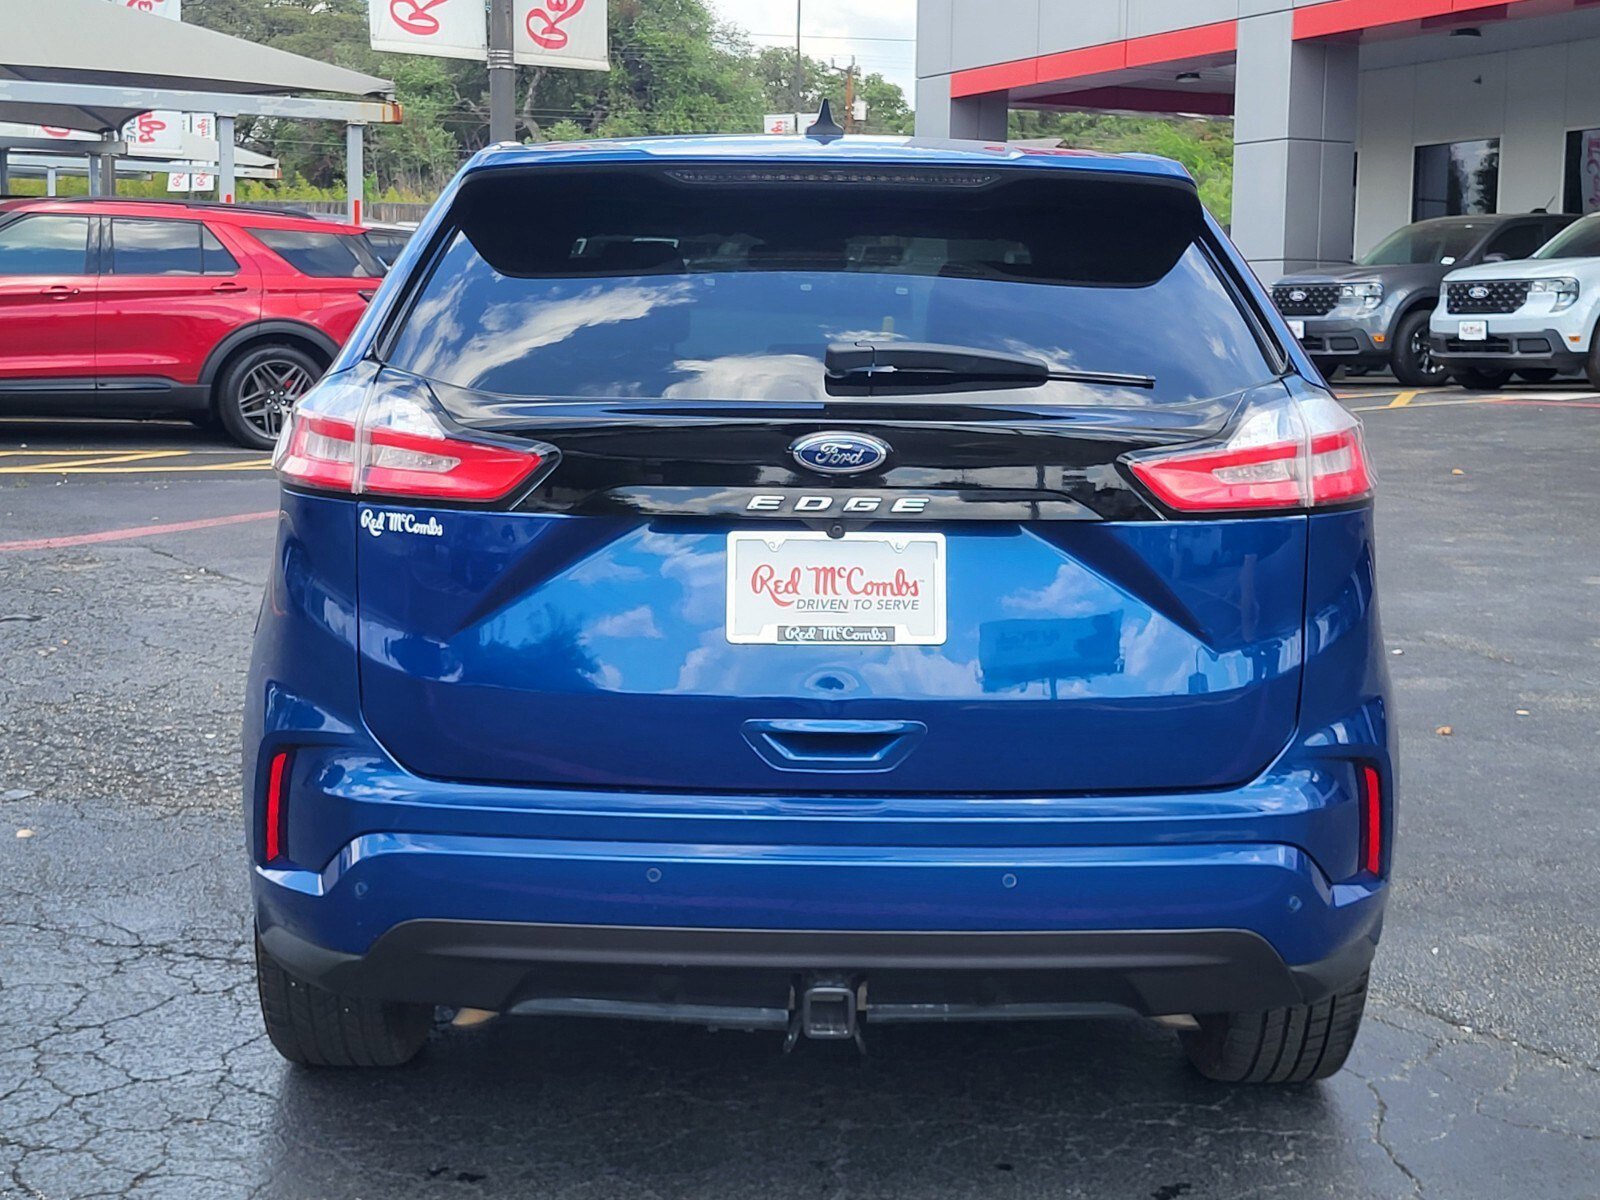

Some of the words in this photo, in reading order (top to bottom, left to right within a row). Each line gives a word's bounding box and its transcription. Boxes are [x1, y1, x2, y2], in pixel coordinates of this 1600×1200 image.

[815, 443, 864, 465] Ford
[746, 495, 930, 513] EDGE
[361, 508, 385, 537] Red
[386, 511, 443, 536] McCombs
[751, 564, 801, 607] Red
[805, 565, 919, 597] McCombs
[796, 599, 849, 610] DRIVEN
[854, 599, 872, 610] TO
[877, 599, 919, 611] SERVE
[784, 626, 816, 642] Red
[819, 626, 887, 641] McCombs
